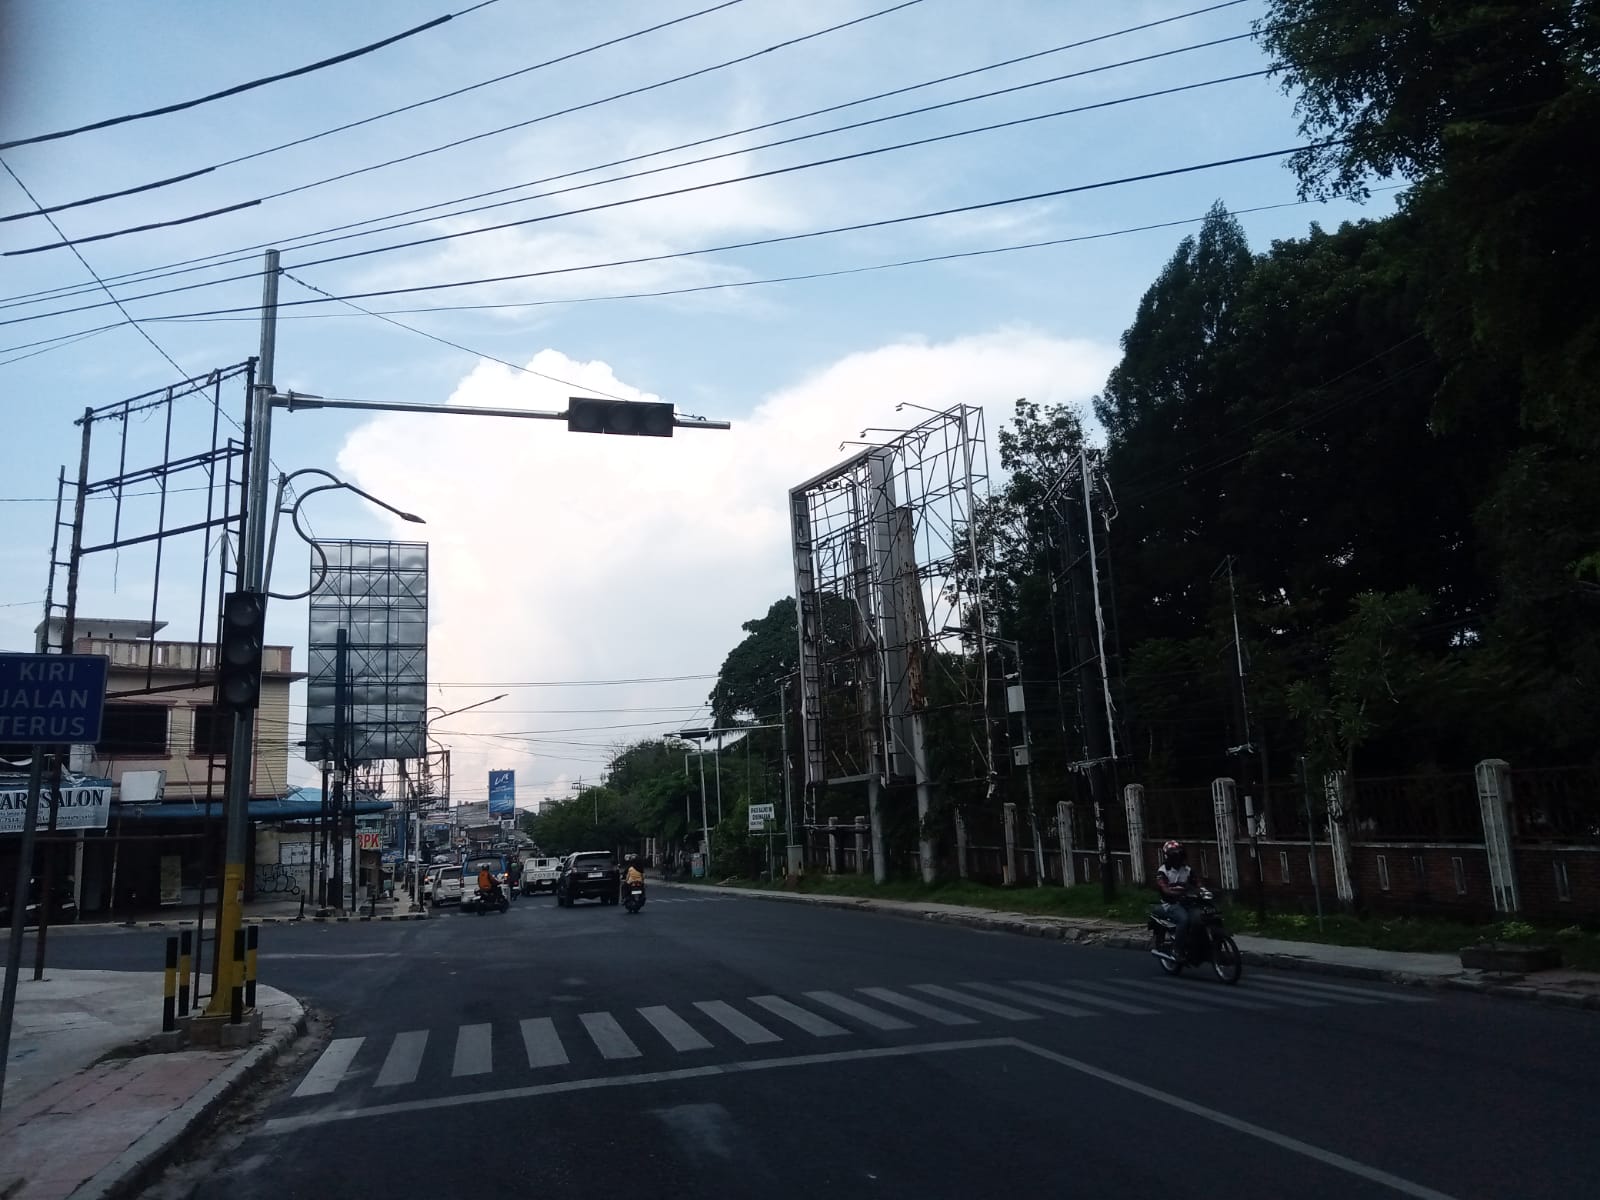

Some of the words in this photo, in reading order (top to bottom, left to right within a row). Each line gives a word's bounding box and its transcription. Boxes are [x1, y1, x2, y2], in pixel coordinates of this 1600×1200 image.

[19, 662, 75, 681] KIRI
[0, 689, 88, 709] JALAN
[42, 789, 104, 809] SALON
